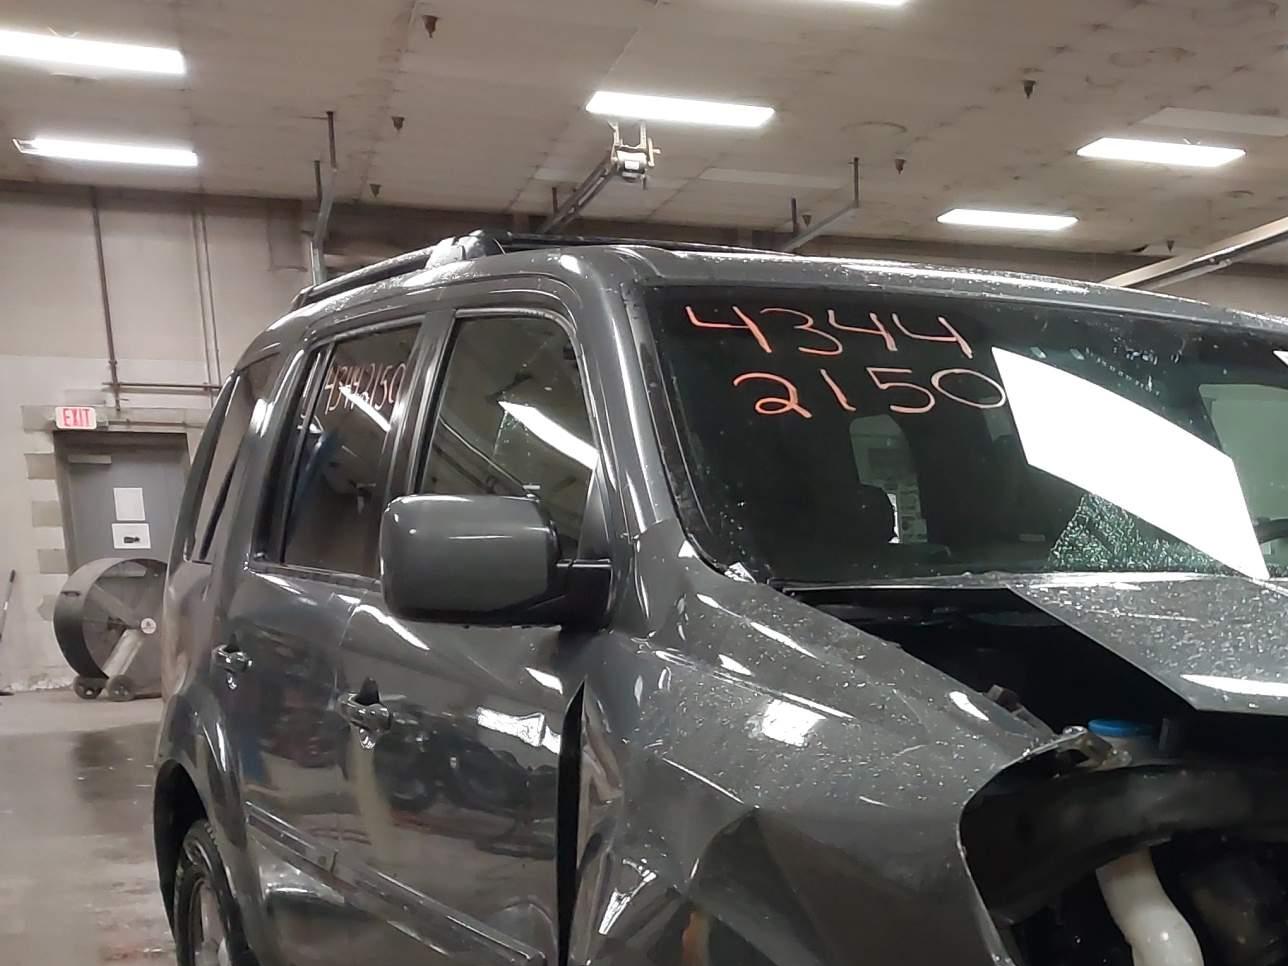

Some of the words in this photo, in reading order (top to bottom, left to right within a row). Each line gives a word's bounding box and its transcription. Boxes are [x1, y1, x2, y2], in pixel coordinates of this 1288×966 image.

[686, 305, 973, 359] 4344
[62, 408, 90, 427] EXIT
[732, 368, 1007, 418] 2150
